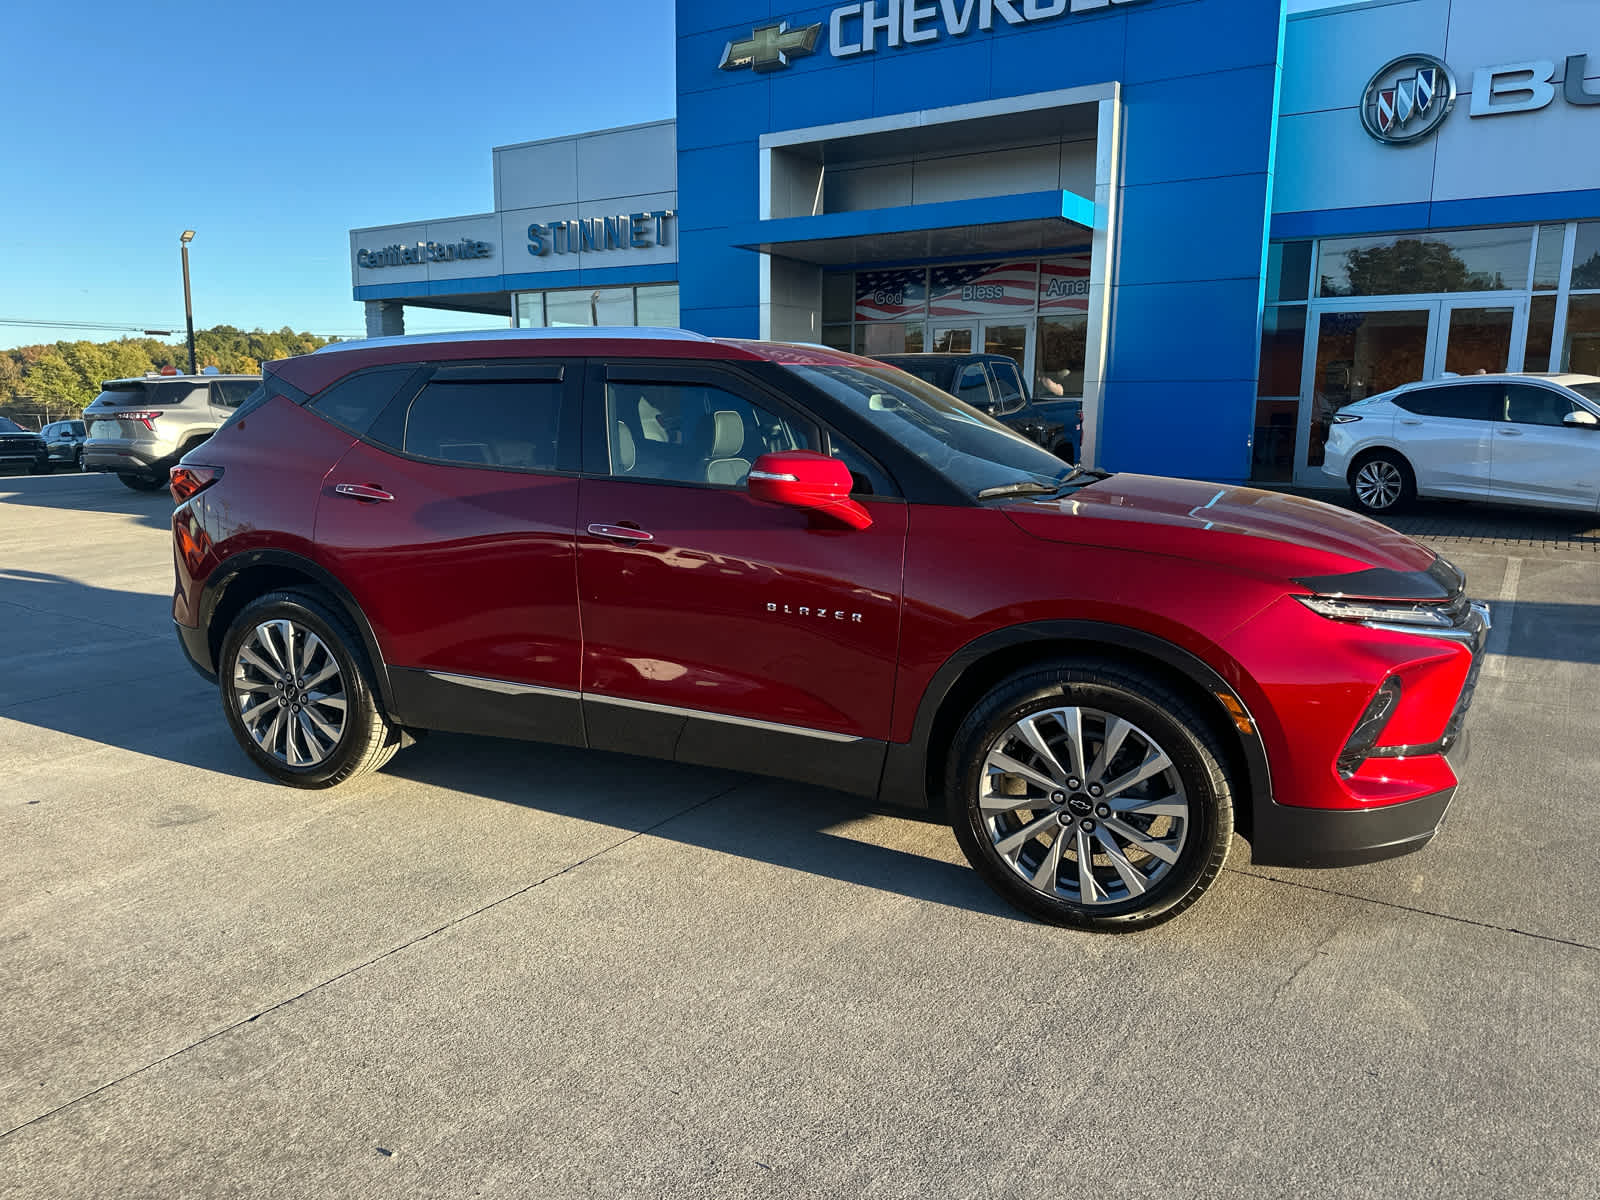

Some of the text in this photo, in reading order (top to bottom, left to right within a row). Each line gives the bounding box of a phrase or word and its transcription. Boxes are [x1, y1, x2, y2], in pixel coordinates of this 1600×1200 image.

[829, 0, 1134, 57] CHEVR
[528, 210, 678, 256] STINNET
[357, 238, 488, 269] Certified Service
[874, 289, 904, 304] God
[961, 284, 1004, 301] Bless
[766, 602, 863, 623] BLAZER
